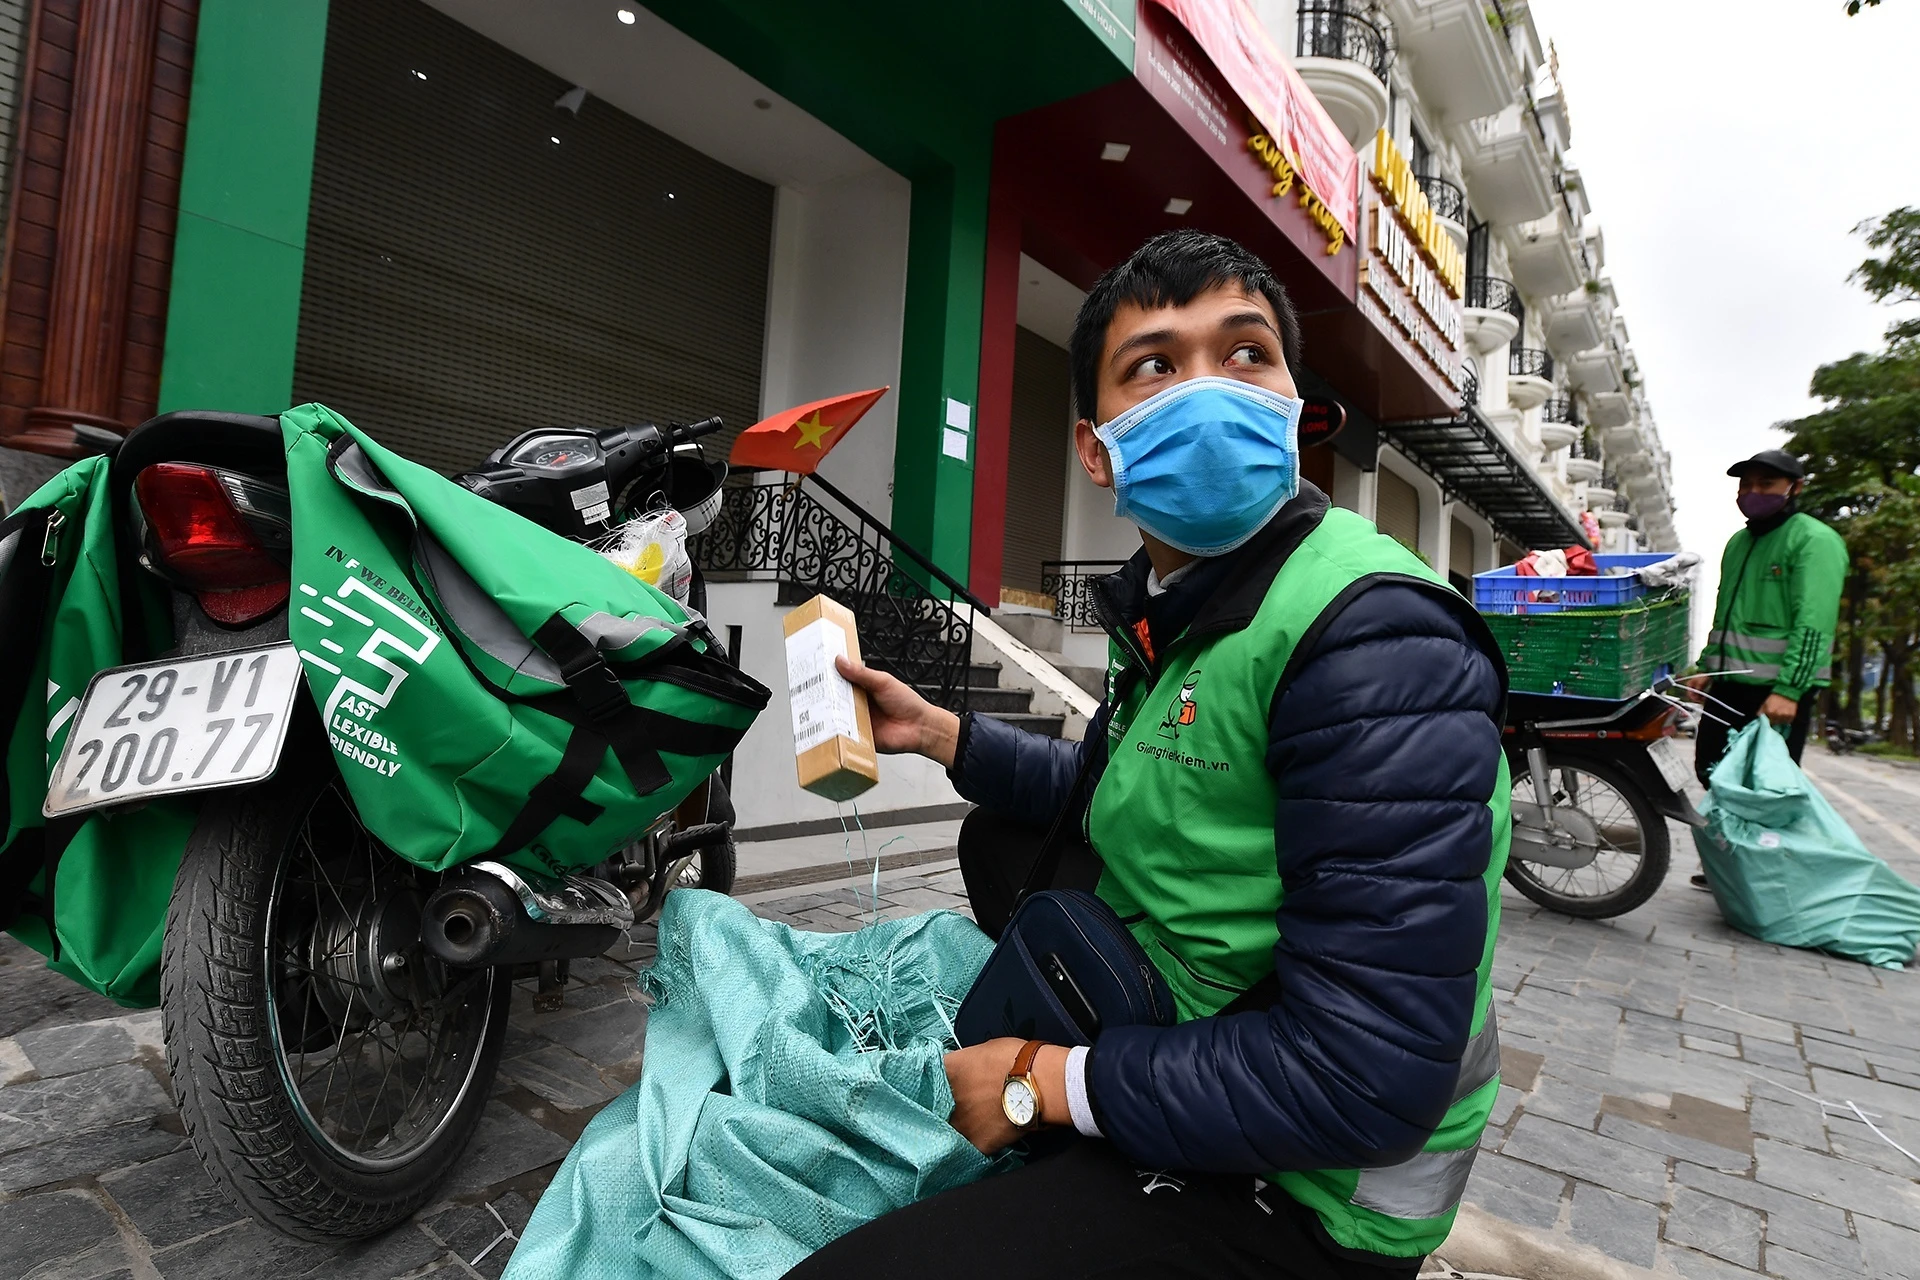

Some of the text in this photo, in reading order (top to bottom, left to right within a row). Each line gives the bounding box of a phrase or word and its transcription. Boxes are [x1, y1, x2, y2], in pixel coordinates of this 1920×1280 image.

[324, 545, 348, 563] IN
[344, 558, 360, 569] F
[360, 566, 387, 590] WE
[103, 654, 269, 729] 29-V1
[339, 696, 379, 722] AST
[329, 731, 402, 778] RIENDLY
[332, 713, 399, 756] LEXIBLE
[63, 712, 274, 804] 200.77
